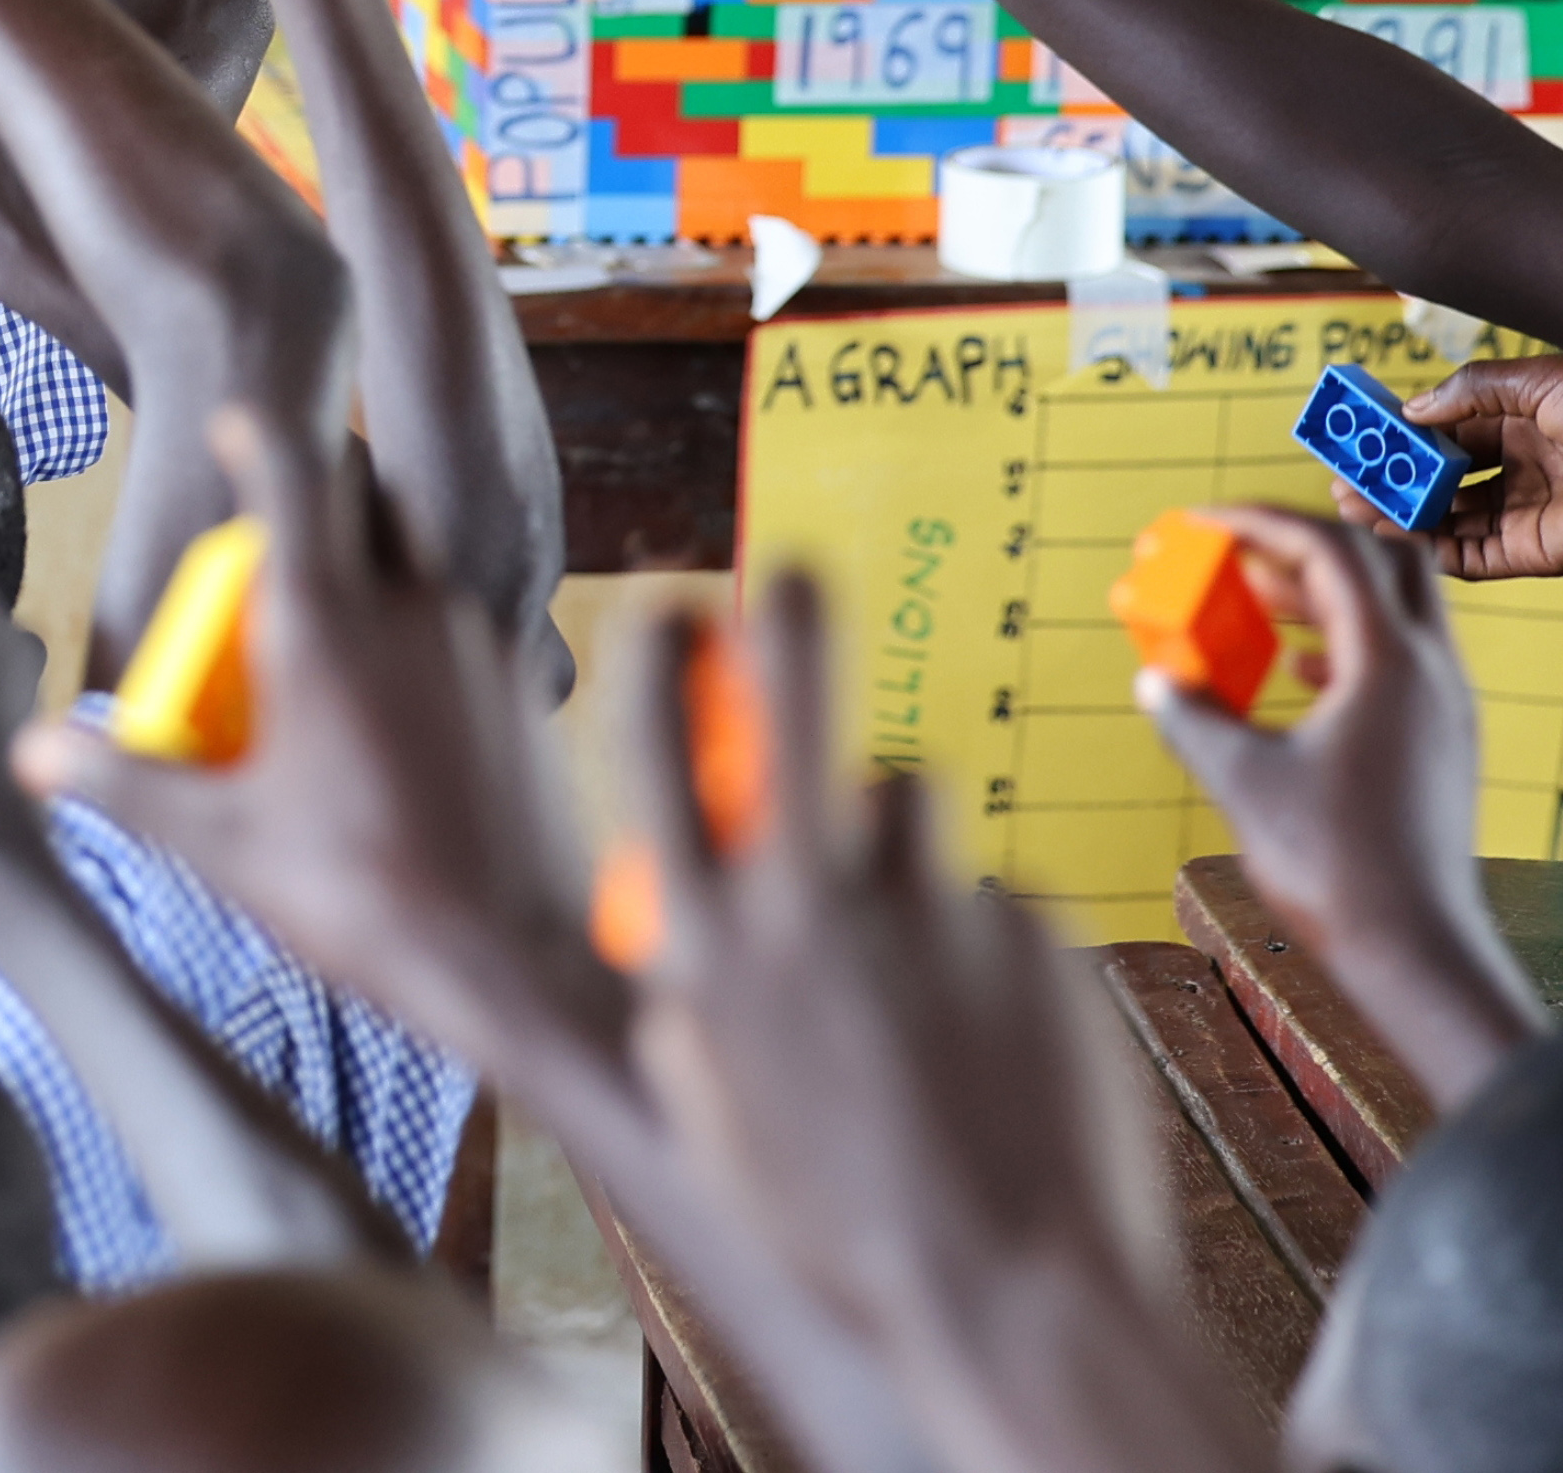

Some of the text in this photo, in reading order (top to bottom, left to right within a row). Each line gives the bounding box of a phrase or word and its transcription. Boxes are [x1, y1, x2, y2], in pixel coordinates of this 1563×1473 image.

[795, 8, 973, 100] 1969
[760, 336, 817, 414] A
[829, 330, 1033, 408] GRAPH
